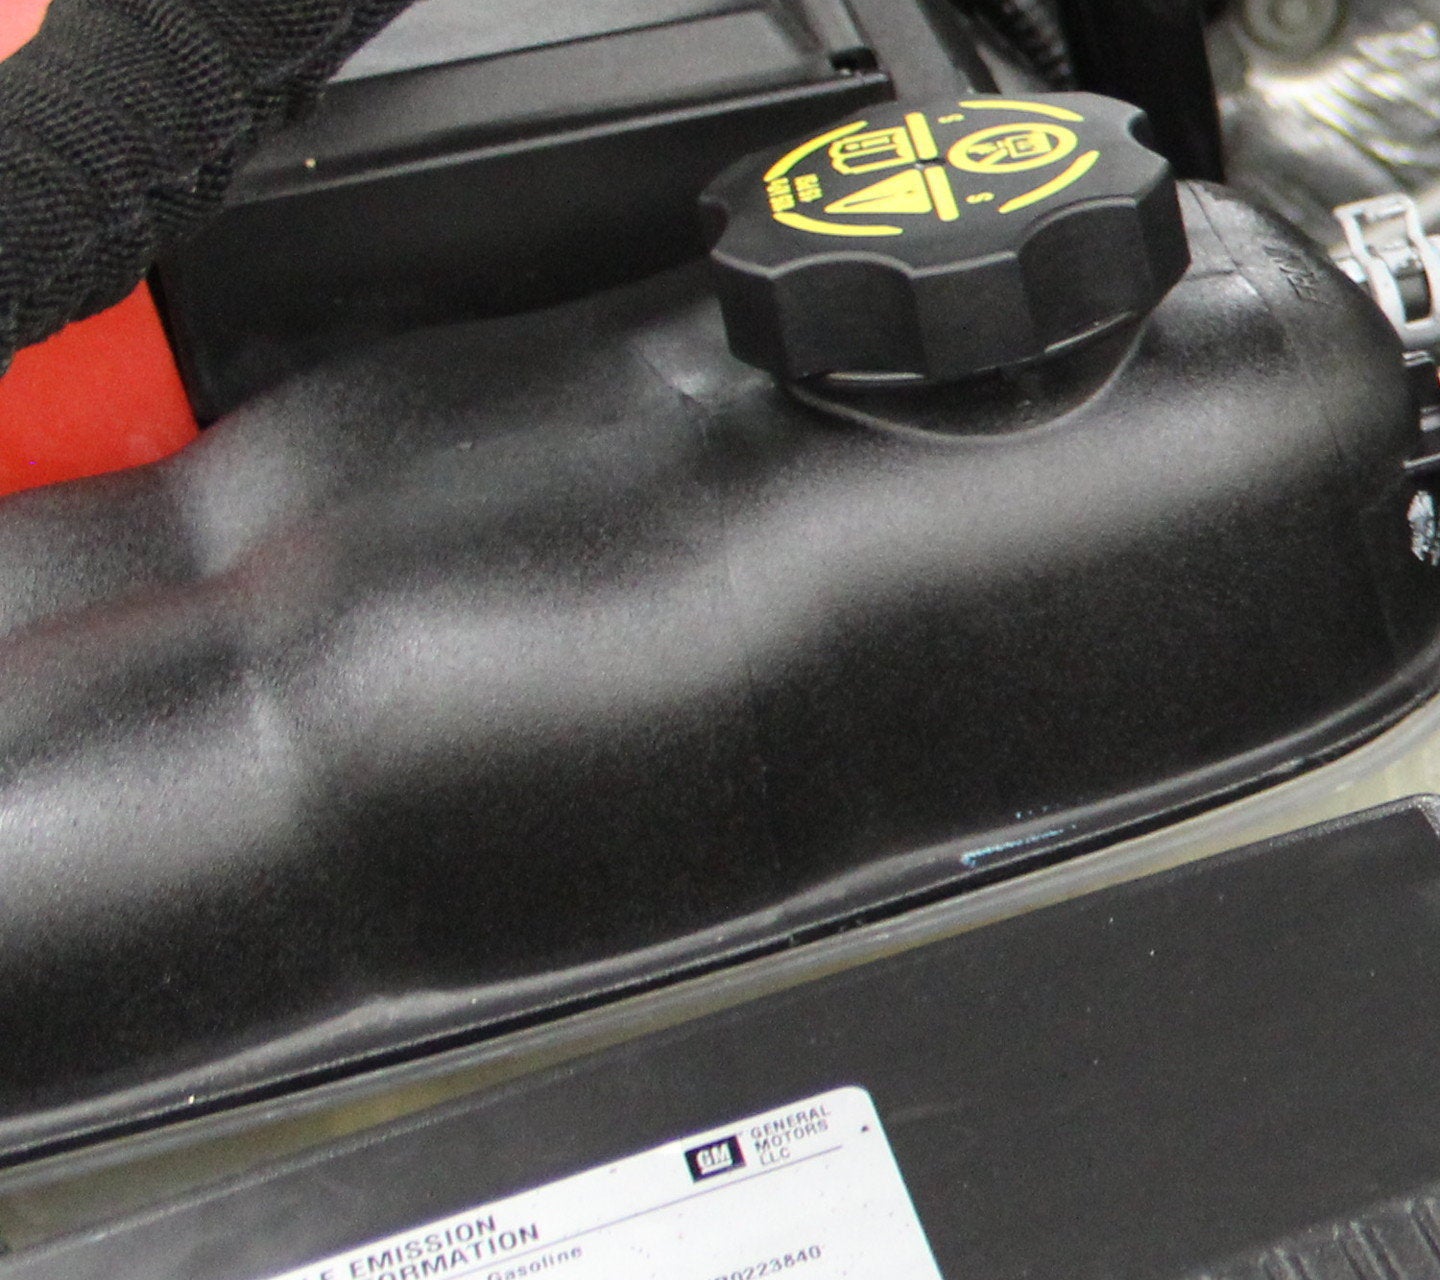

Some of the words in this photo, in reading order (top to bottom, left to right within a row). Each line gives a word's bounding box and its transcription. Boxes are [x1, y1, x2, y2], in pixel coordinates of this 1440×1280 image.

[747, 1103, 831, 1140] GENERAL
[751, 1118, 830, 1154] MOTORS
[692, 1141, 736, 1172] GM
[757, 1145, 792, 1166] LLC
[348, 1214, 497, 1280] EMISSION
